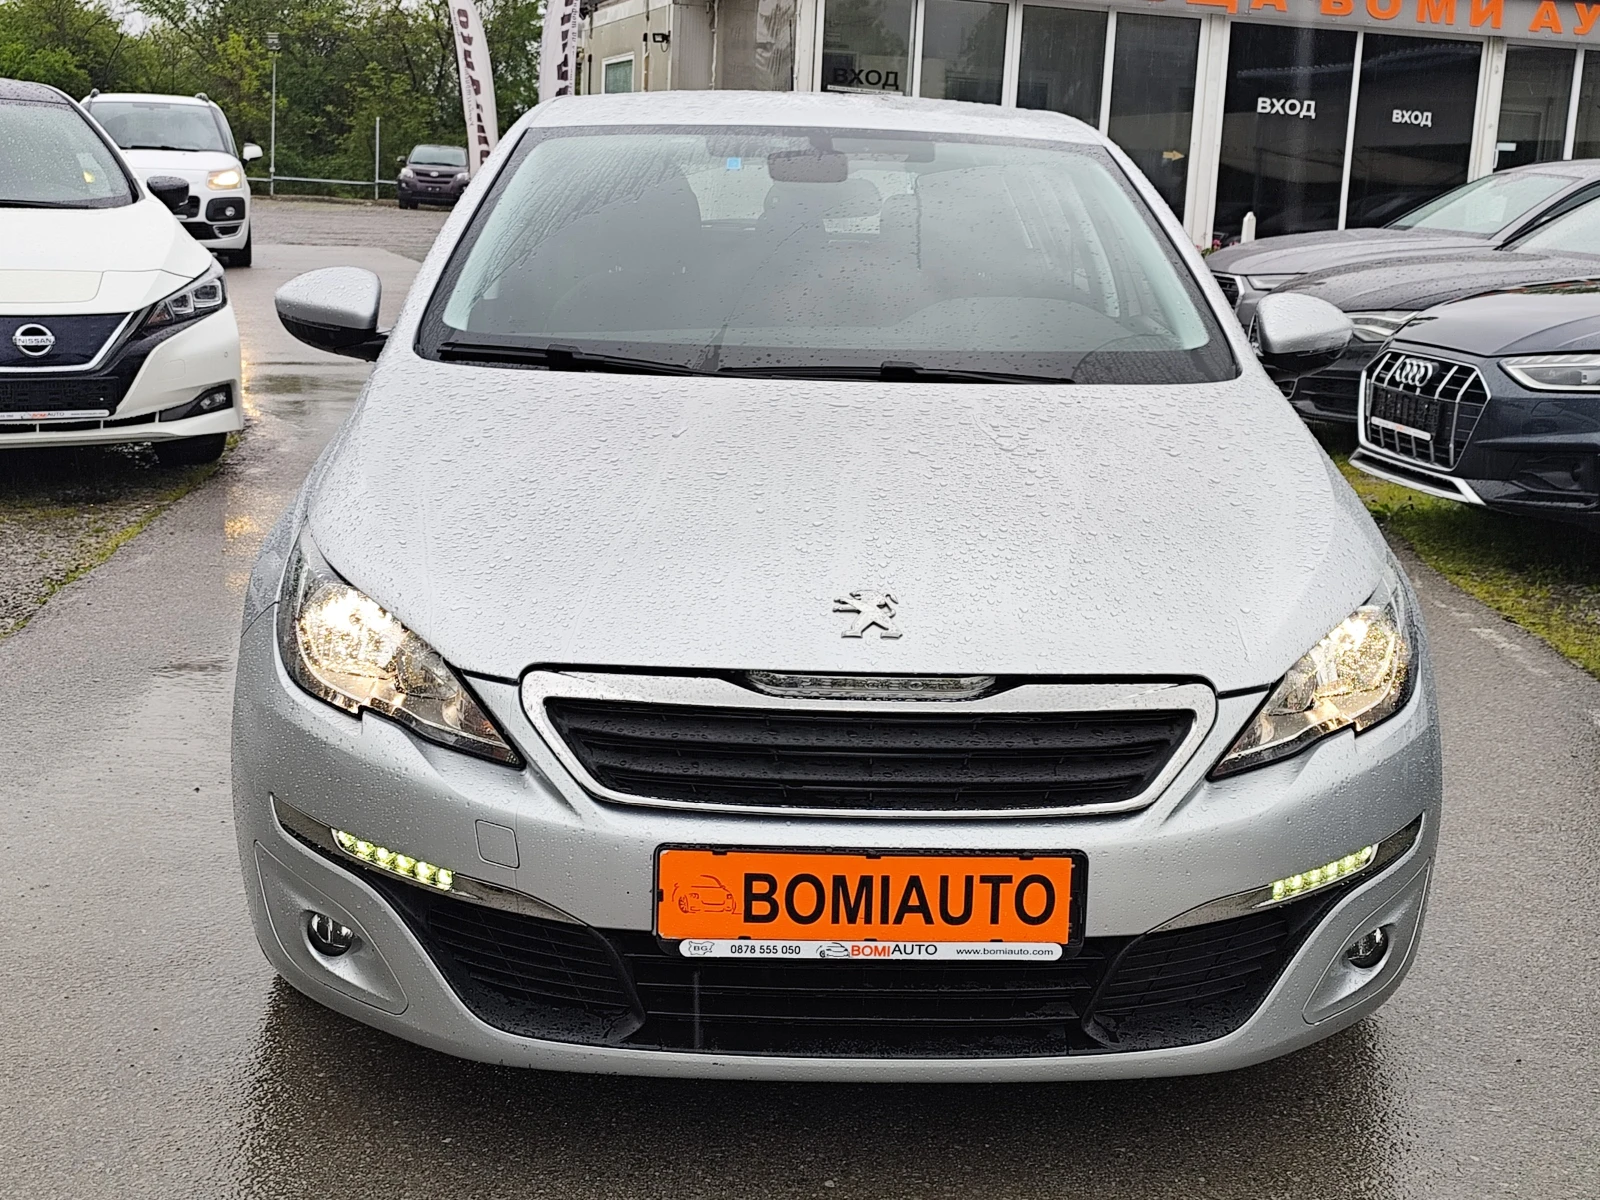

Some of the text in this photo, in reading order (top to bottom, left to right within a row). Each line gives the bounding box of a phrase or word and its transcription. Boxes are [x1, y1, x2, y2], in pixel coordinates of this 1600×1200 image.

[833, 68, 899, 91] ВХОД
[1257, 97, 1316, 119] ВХОД
[1391, 109, 1433, 127] ВХОД
[742, 872, 1056, 927] BOMIAUTO
[730, 944, 756, 954] 0878
[759, 945, 779, 954] 555
[781, 945, 801, 955] 050
[956, 947, 1054, 956] www.bomiauto.com
